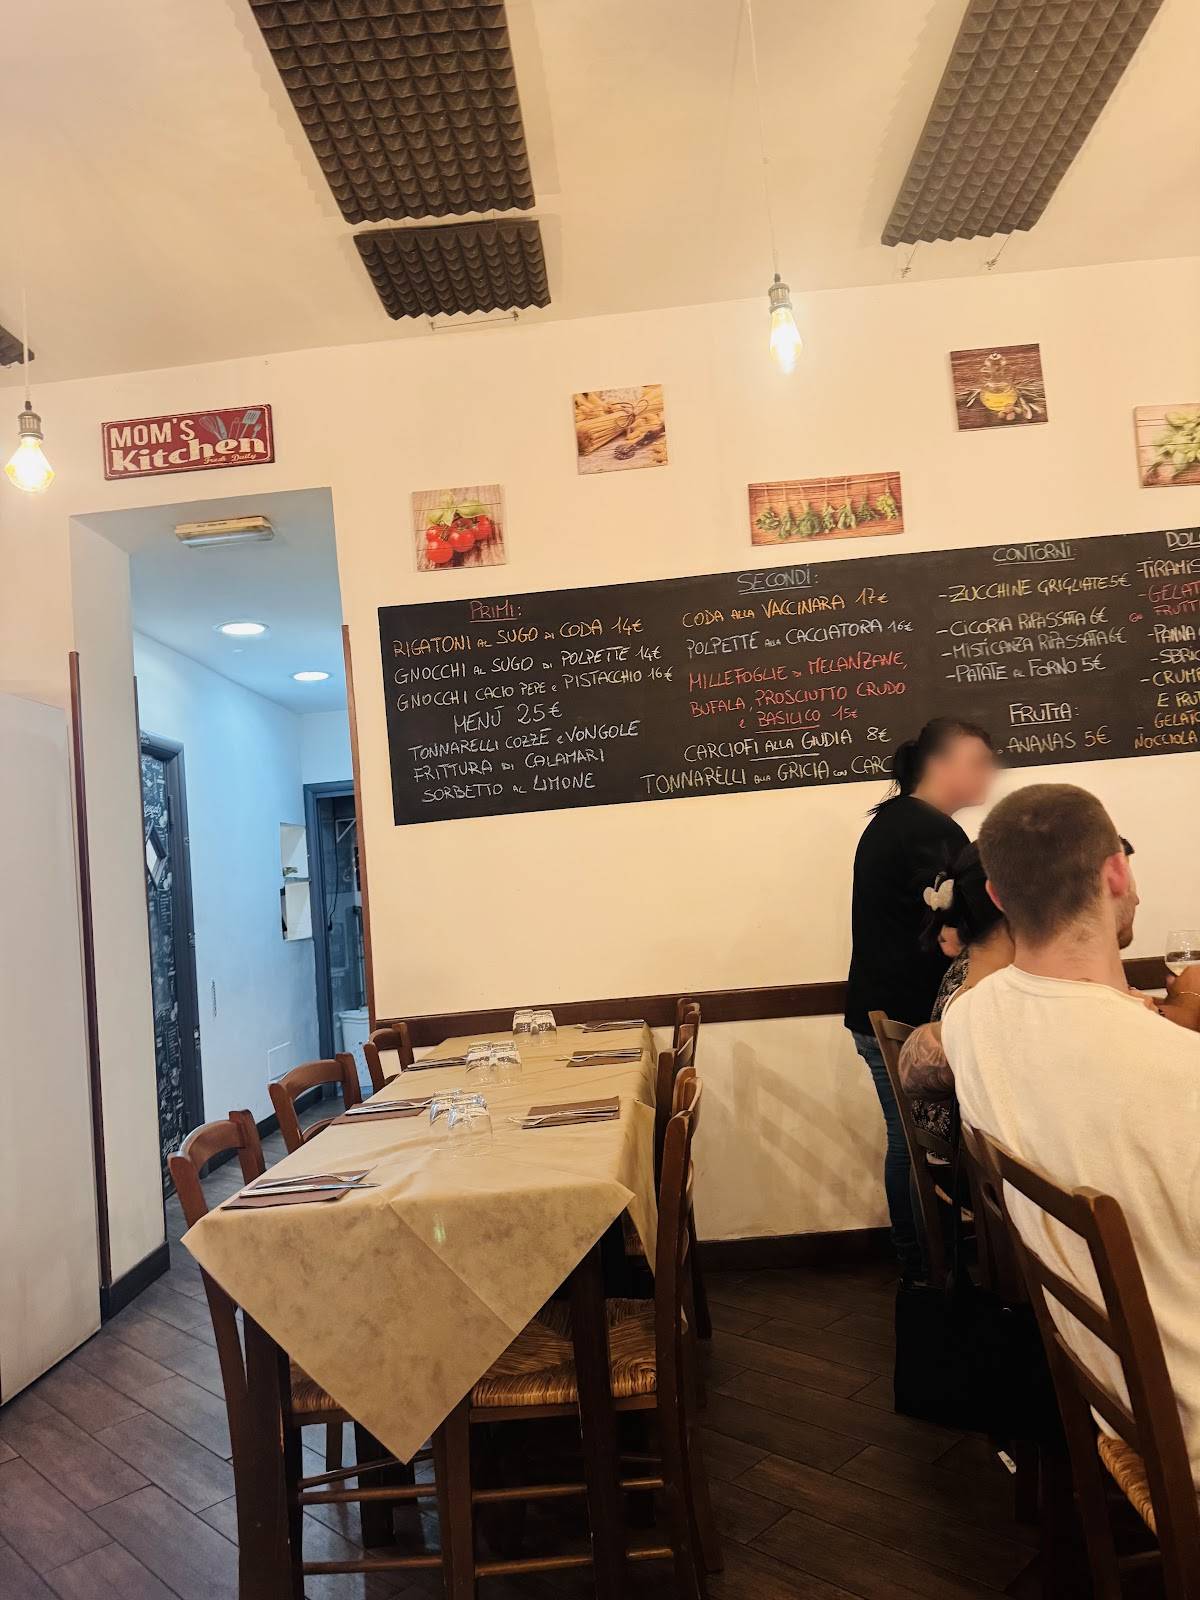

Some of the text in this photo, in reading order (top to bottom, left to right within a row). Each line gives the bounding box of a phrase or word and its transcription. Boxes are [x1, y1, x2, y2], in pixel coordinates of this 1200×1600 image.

[110, 418, 195, 448] MOM'S
[111, 437, 266, 471] Kitchen
[1165, 531, 1200, 548] DOL
[470, 600, 522, 620] PRIMI:
[682, 587, 889, 628] CODA ALLA VACCINARA 17€
[1089, 606, 1109, 625] 6€
[393, 635, 471, 657] RIGATONI
[477, 639, 491, 648] AL
[496, 627, 539, 645] SUGO
[560, 618, 602, 638] CODA
[611, 616, 644, 635] 14€
[686, 619, 915, 659] POLPETTE ALLA CACCIATORA 16€
[394, 664, 467, 685] GNOCCHI
[473, 666, 487, 675] AL
[491, 656, 534, 673] SUGO
[561, 645, 630, 667] POLPETTE
[635, 645, 663, 661] 14€
[688, 665, 788, 692] MILLEFOGLIE
[808, 650, 909, 675] MELANZANE,
[1028, 657, 1078, 677] FORNO
[1081, 653, 1107, 672] 5€
[397, 688, 468, 711] GNOCCHI
[475, 685, 514, 702] CACIO
[519, 681, 546, 696] PEPE
[565, 670, 642, 689] PISTACCHIO
[647, 666, 673, 683] 16€
[689, 681, 907, 718] BUFALA, PROSCIUTTO CRUDO
[1157, 692, 1169, 707] E
[517, 701, 563, 725] 25€
[757, 709, 821, 728] BASILICO
[831, 704, 858, 721] 15€
[1009, 702, 1080, 724] FRUTTA:
[408, 740, 499, 761] TONNARELLI
[505, 728, 552, 749] COZZE
[566, 719, 641, 743] VONGOLE
[684, 738, 759, 763] CARCIOFI
[765, 738, 794, 753] ALLA
[866, 726, 892, 743] 8€
[1084, 725, 1112, 748] 5€
[1134, 730, 1198, 750] NOCCIOLA
[414, 759, 493, 783] FRITTURA
[524, 748, 605, 769] CALAMARI
[639, 766, 747, 795] TONNARELLI
[777, 760, 830, 782] GRICIA
[851, 755, 894, 775] CARC
[422, 772, 596, 803] SORBETTO AL LIMONE
